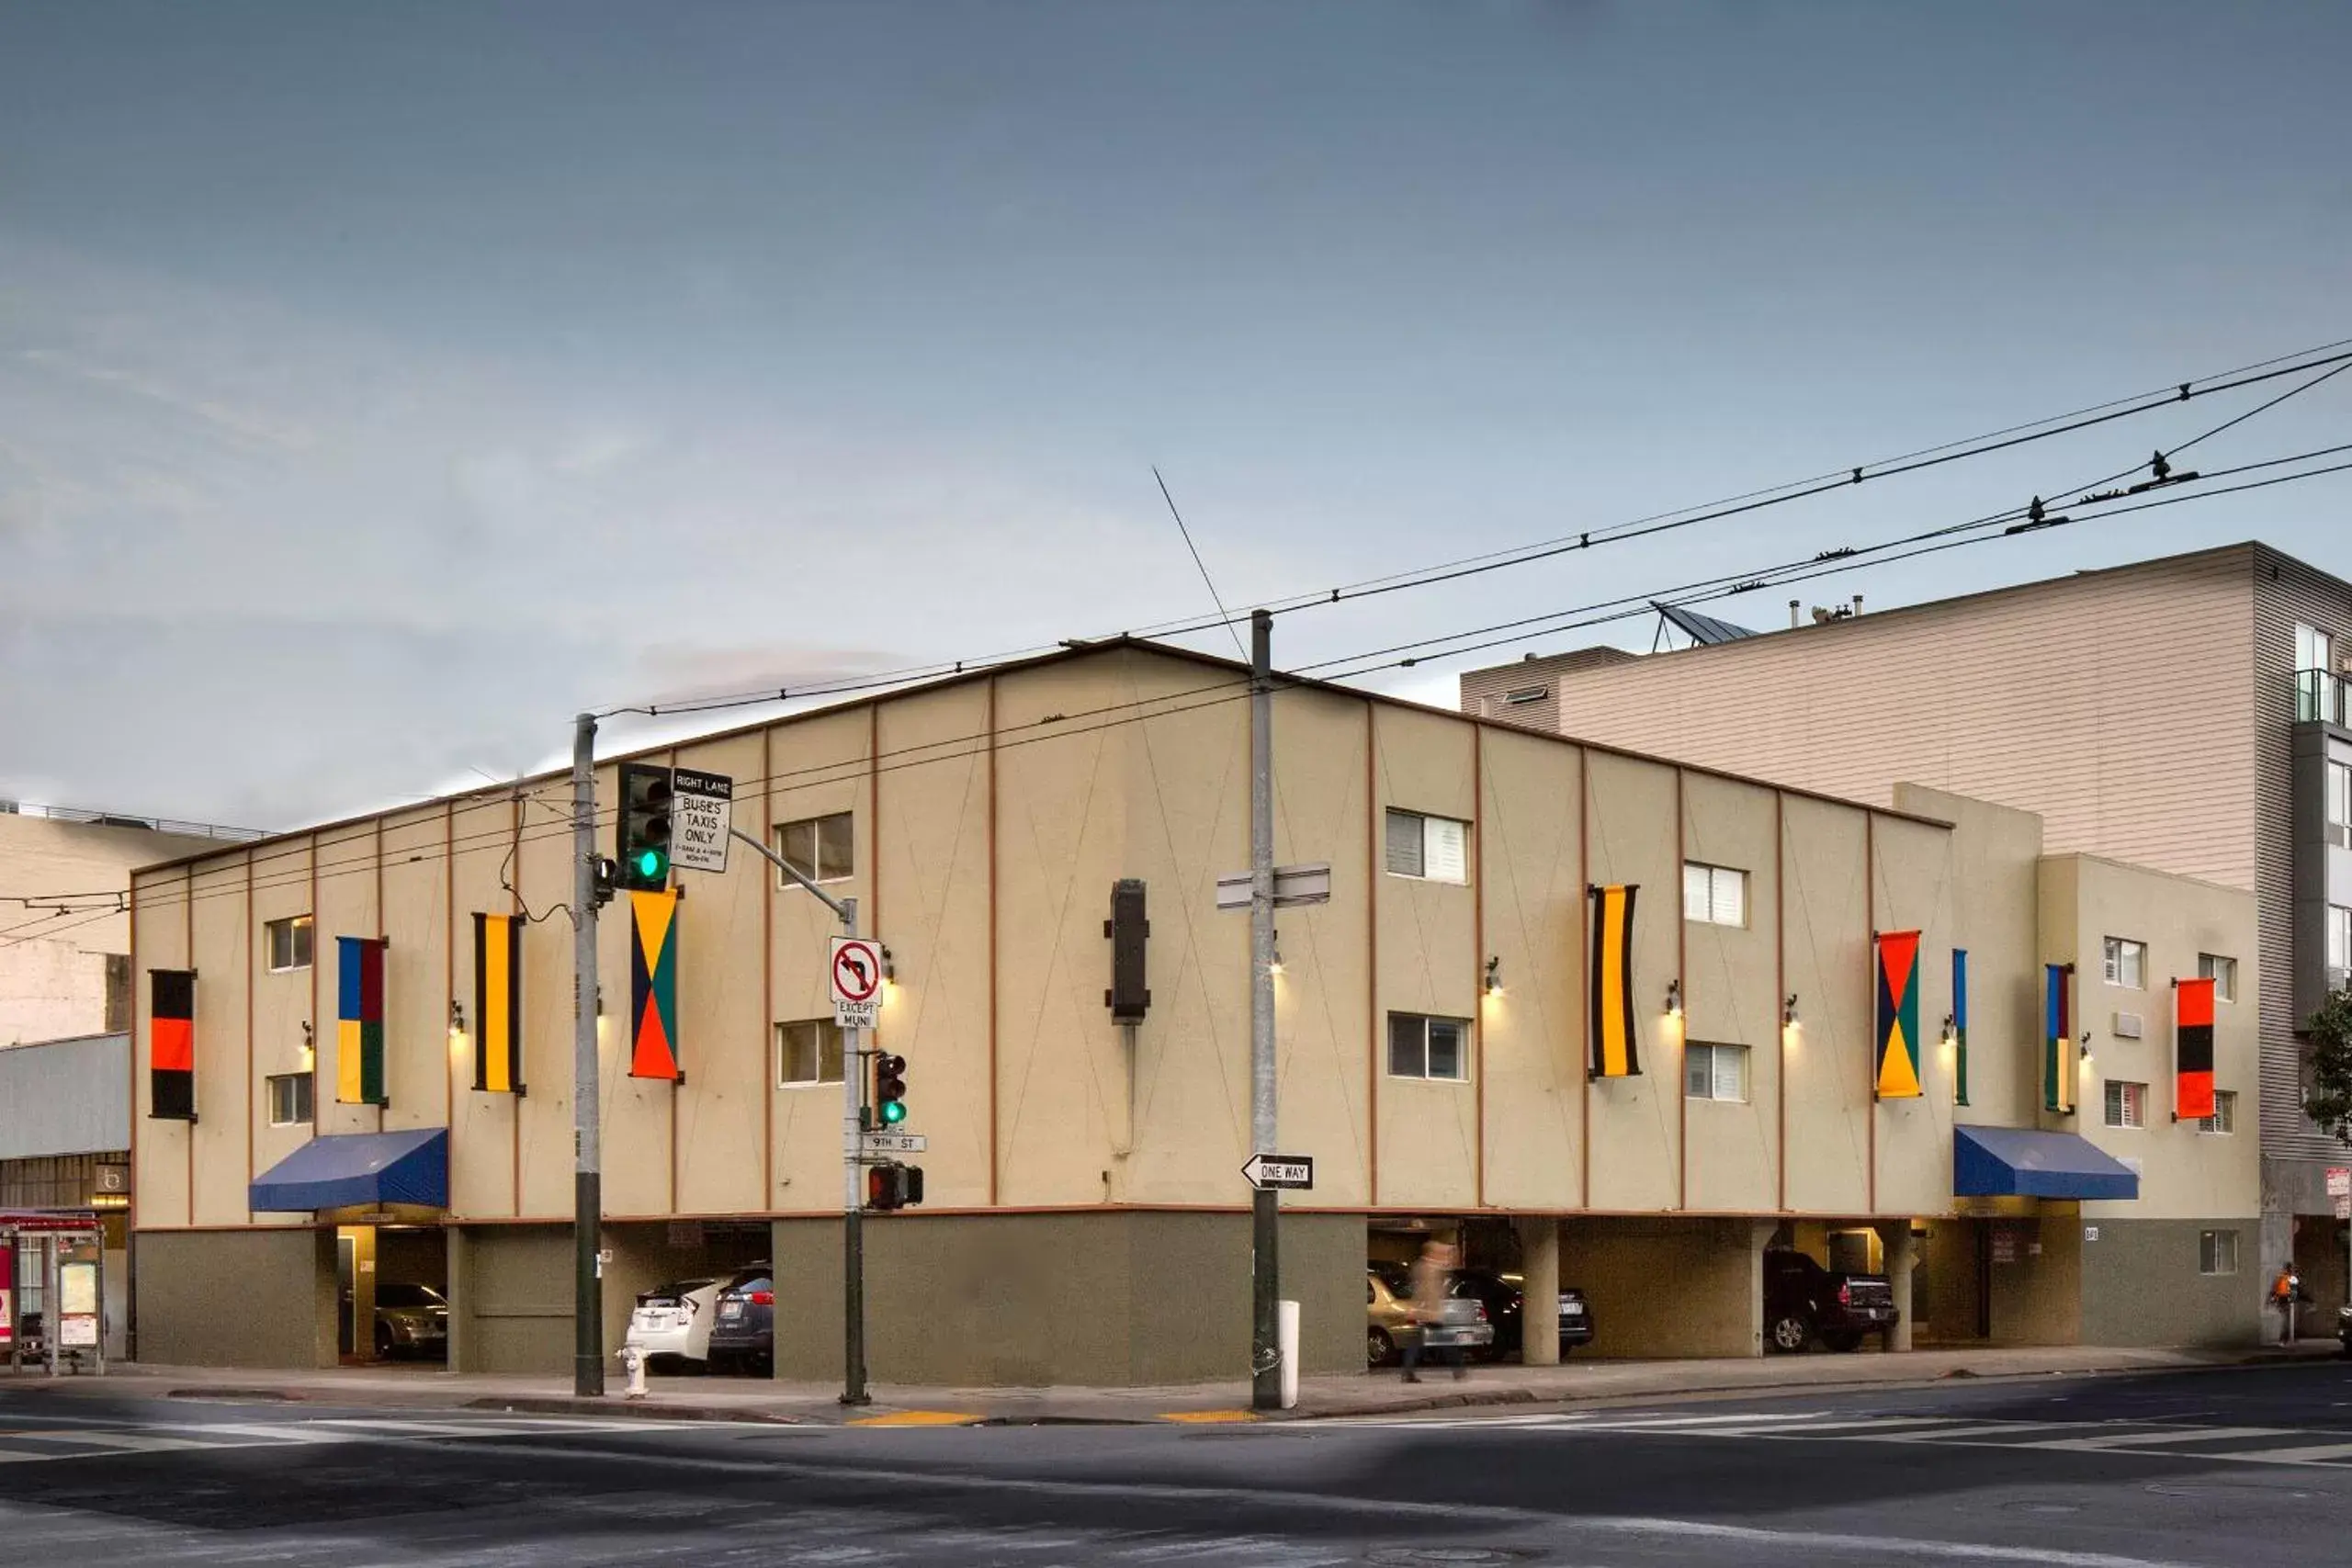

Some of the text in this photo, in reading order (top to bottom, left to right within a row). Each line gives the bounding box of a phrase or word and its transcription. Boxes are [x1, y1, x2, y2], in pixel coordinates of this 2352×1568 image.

[676, 775, 729, 794] RIGHT LANE
[683, 797, 721, 815] BUSES
[686, 813, 718, 829] TAXIS
[684, 829, 716, 843] ONLY
[840, 1001, 875, 1014] EXCEPT
[873, 1138, 914, 1148] 9TH ST
[1261, 1165, 1306, 1179] ONE WAY
